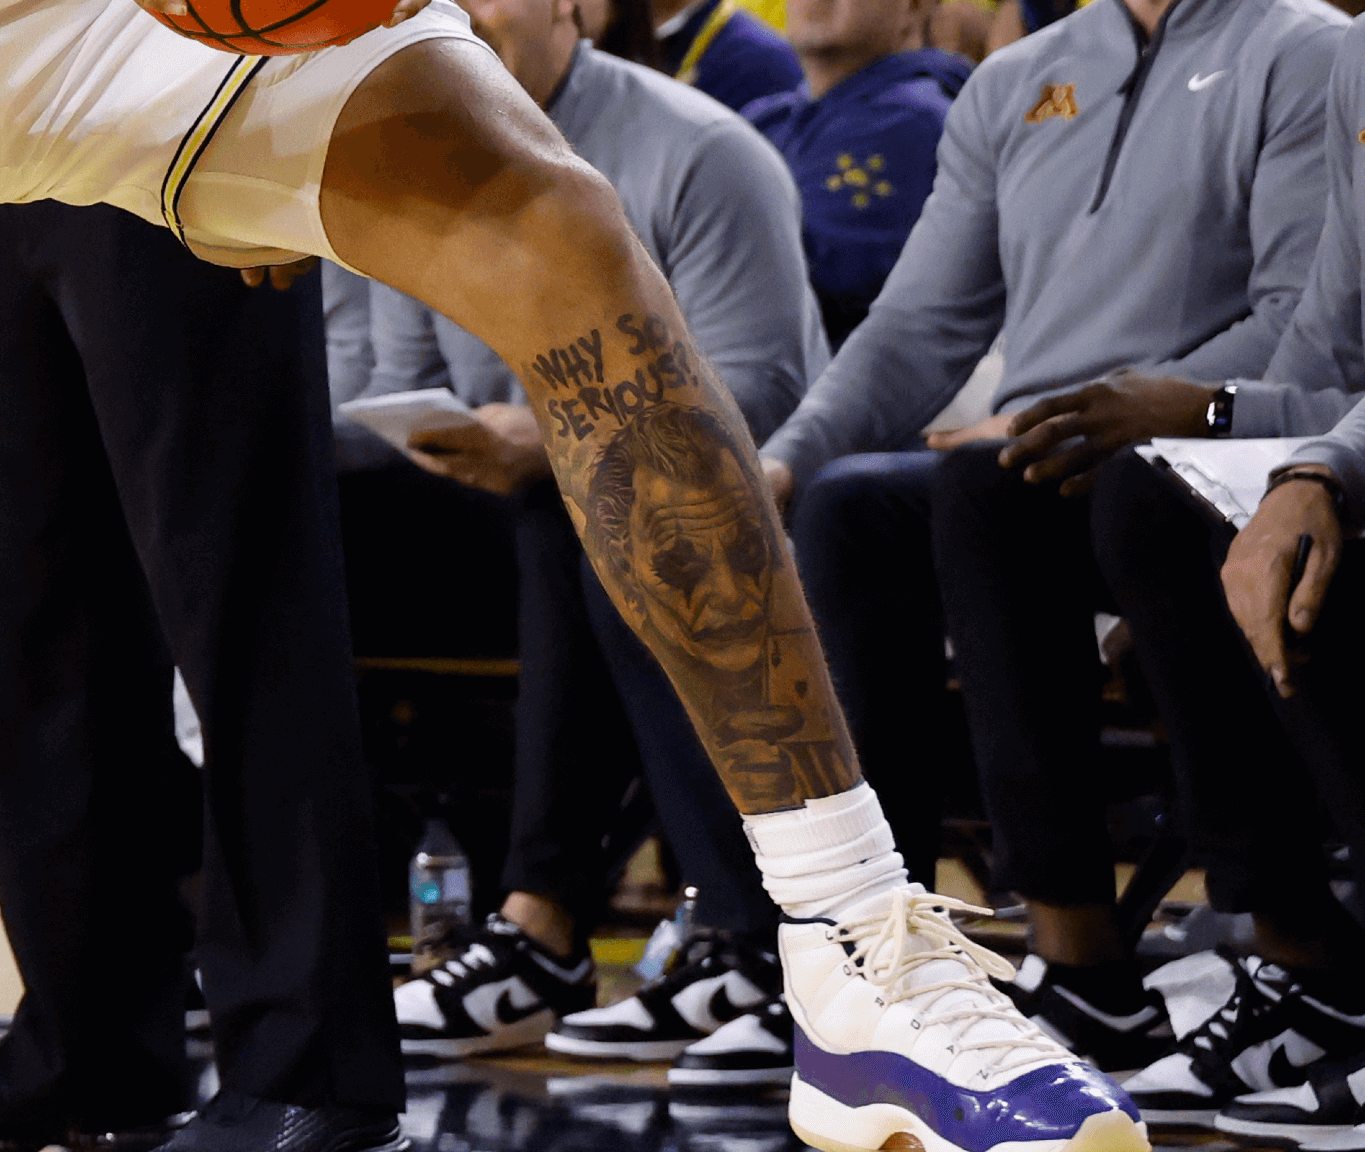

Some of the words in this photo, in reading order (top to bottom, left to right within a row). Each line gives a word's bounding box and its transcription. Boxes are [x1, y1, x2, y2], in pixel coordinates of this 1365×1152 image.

[531, 328, 605, 392] WHY
[615, 313, 669, 355] SO
[547, 340, 700, 442] SERIOUS?
